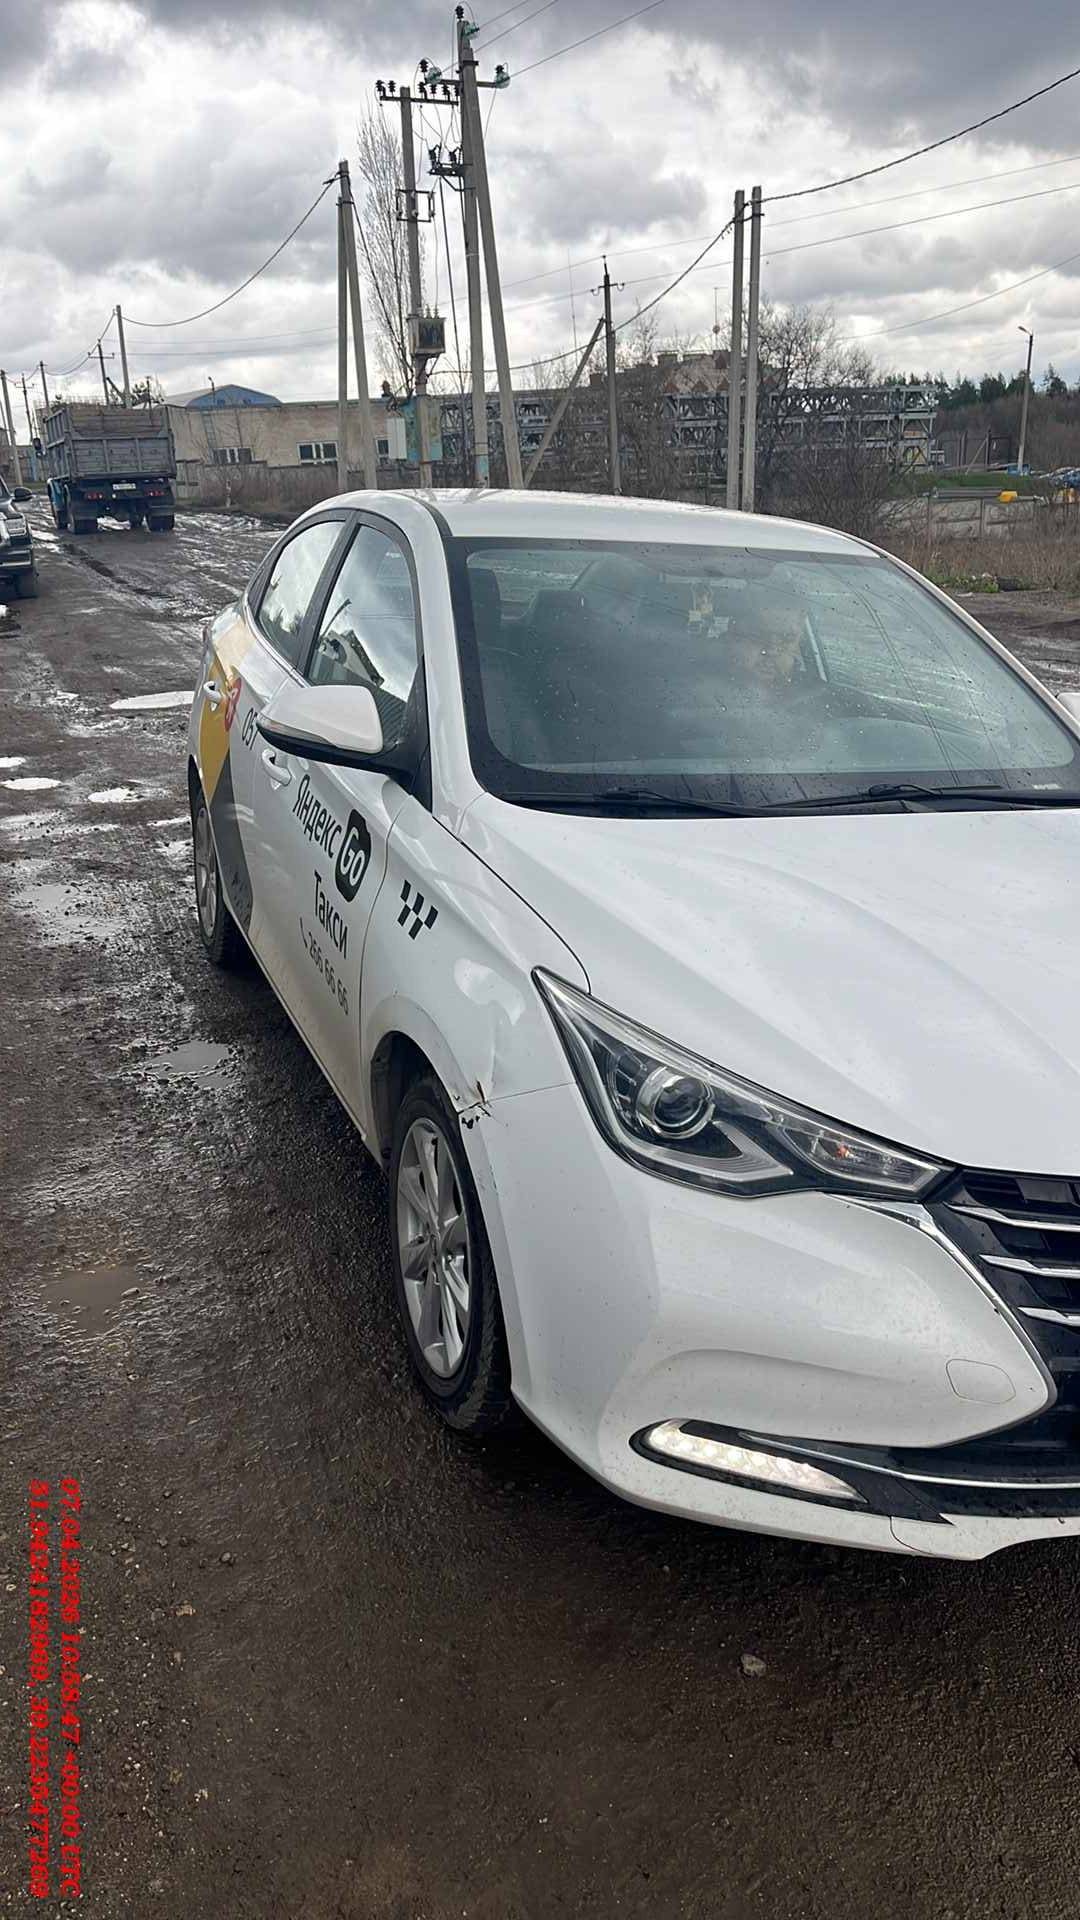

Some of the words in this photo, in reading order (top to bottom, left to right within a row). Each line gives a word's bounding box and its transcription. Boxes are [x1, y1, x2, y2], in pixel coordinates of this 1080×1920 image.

[292, 774, 342, 859] Яндекс
[339, 827, 366, 887] Go
[314, 869, 348, 960] Такси
[324, 957, 335, 994] 66
[337, 978, 349, 1016] 66
